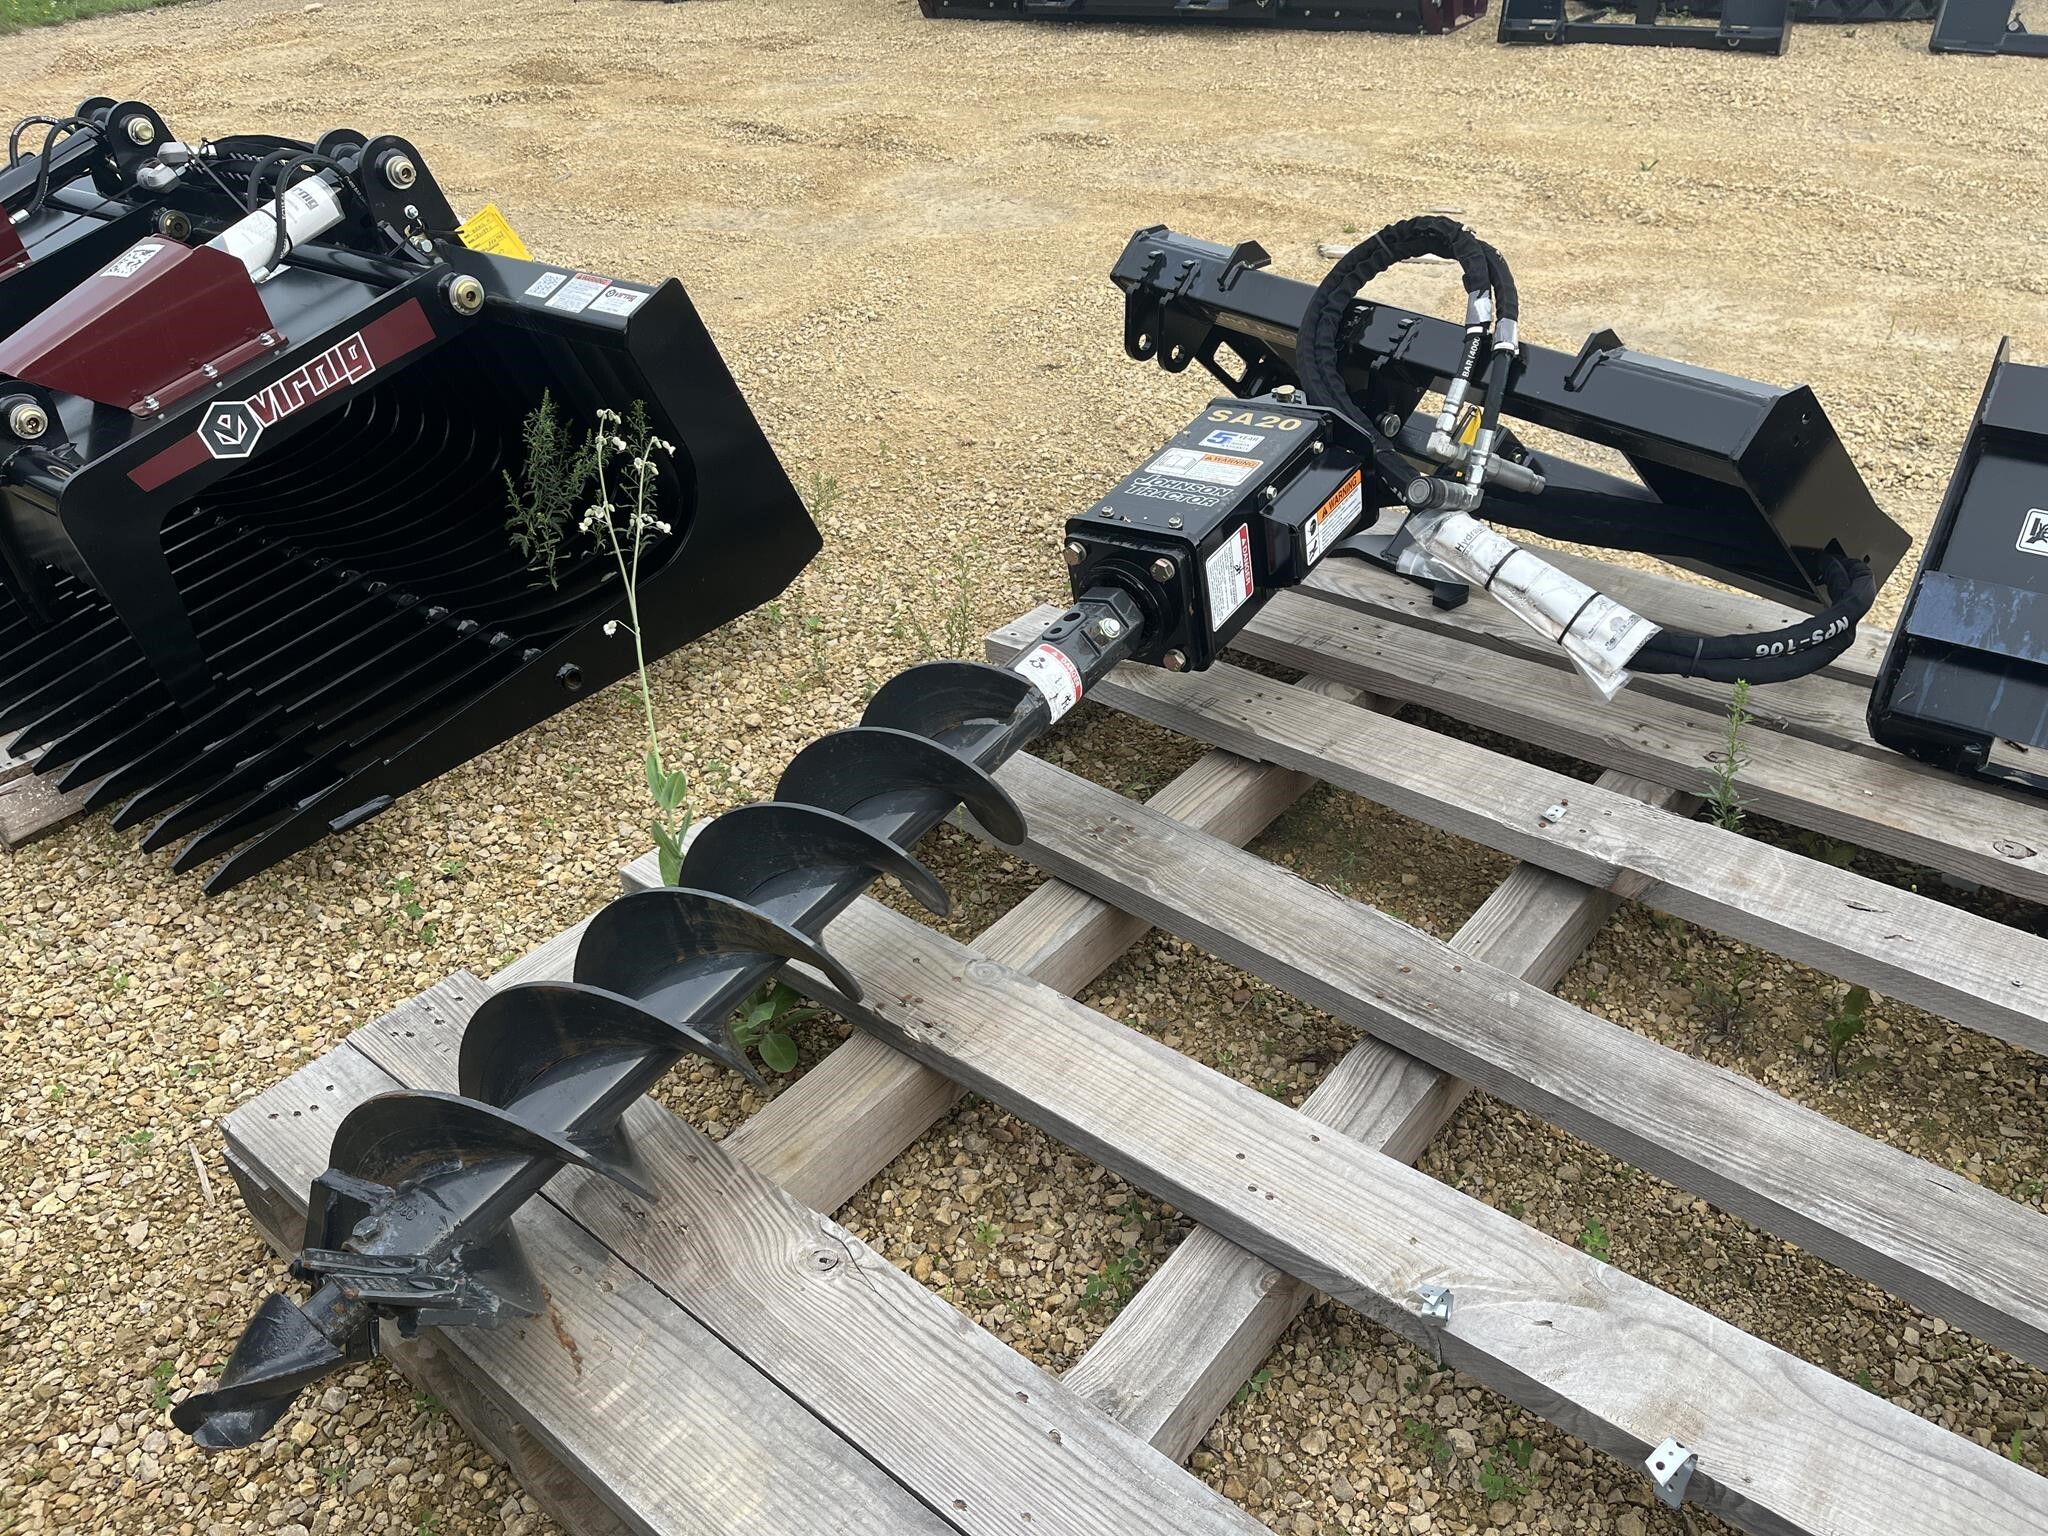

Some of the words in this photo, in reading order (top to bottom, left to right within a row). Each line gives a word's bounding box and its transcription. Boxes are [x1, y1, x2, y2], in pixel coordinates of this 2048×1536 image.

[1462, 359, 1474, 378] BAR
[1207, 409, 1302, 431] SA20
[1213, 456, 1257, 467] WARNING
[1124, 483, 1220, 507] TRACTOR
[1134, 474, 1234, 497] JOHNSON
[1328, 476, 1358, 510] WARNING
[1242, 544, 1252, 586] DANGER
[1755, 615, 1849, 657] NPS-106
[1062, 659, 1080, 687] DANGER
